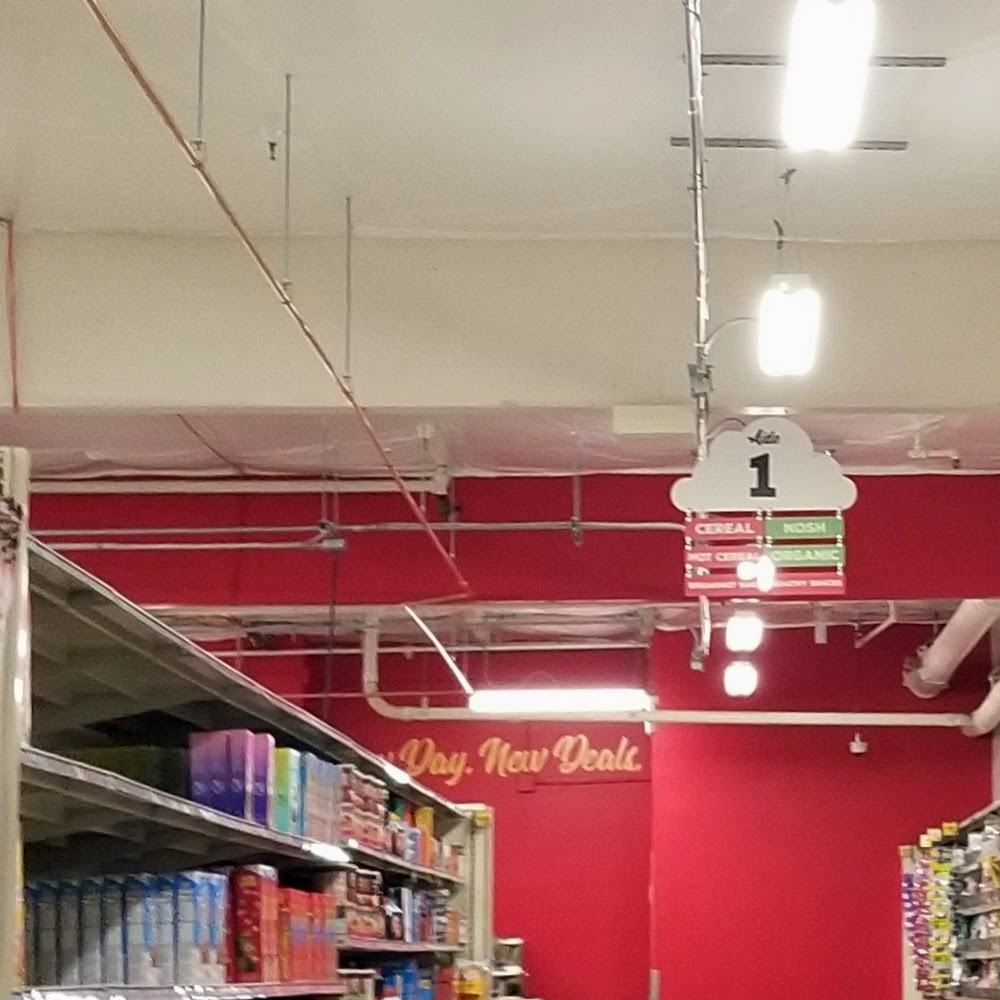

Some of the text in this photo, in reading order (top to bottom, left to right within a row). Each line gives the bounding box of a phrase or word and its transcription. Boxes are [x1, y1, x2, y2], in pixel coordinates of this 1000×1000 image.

[749, 453, 777, 498] 1
[694, 523, 755, 535] CEREAL
[783, 522, 827, 534] NOSH
[478, 736, 550, 778] New
[552, 733, 643, 775] Deals
